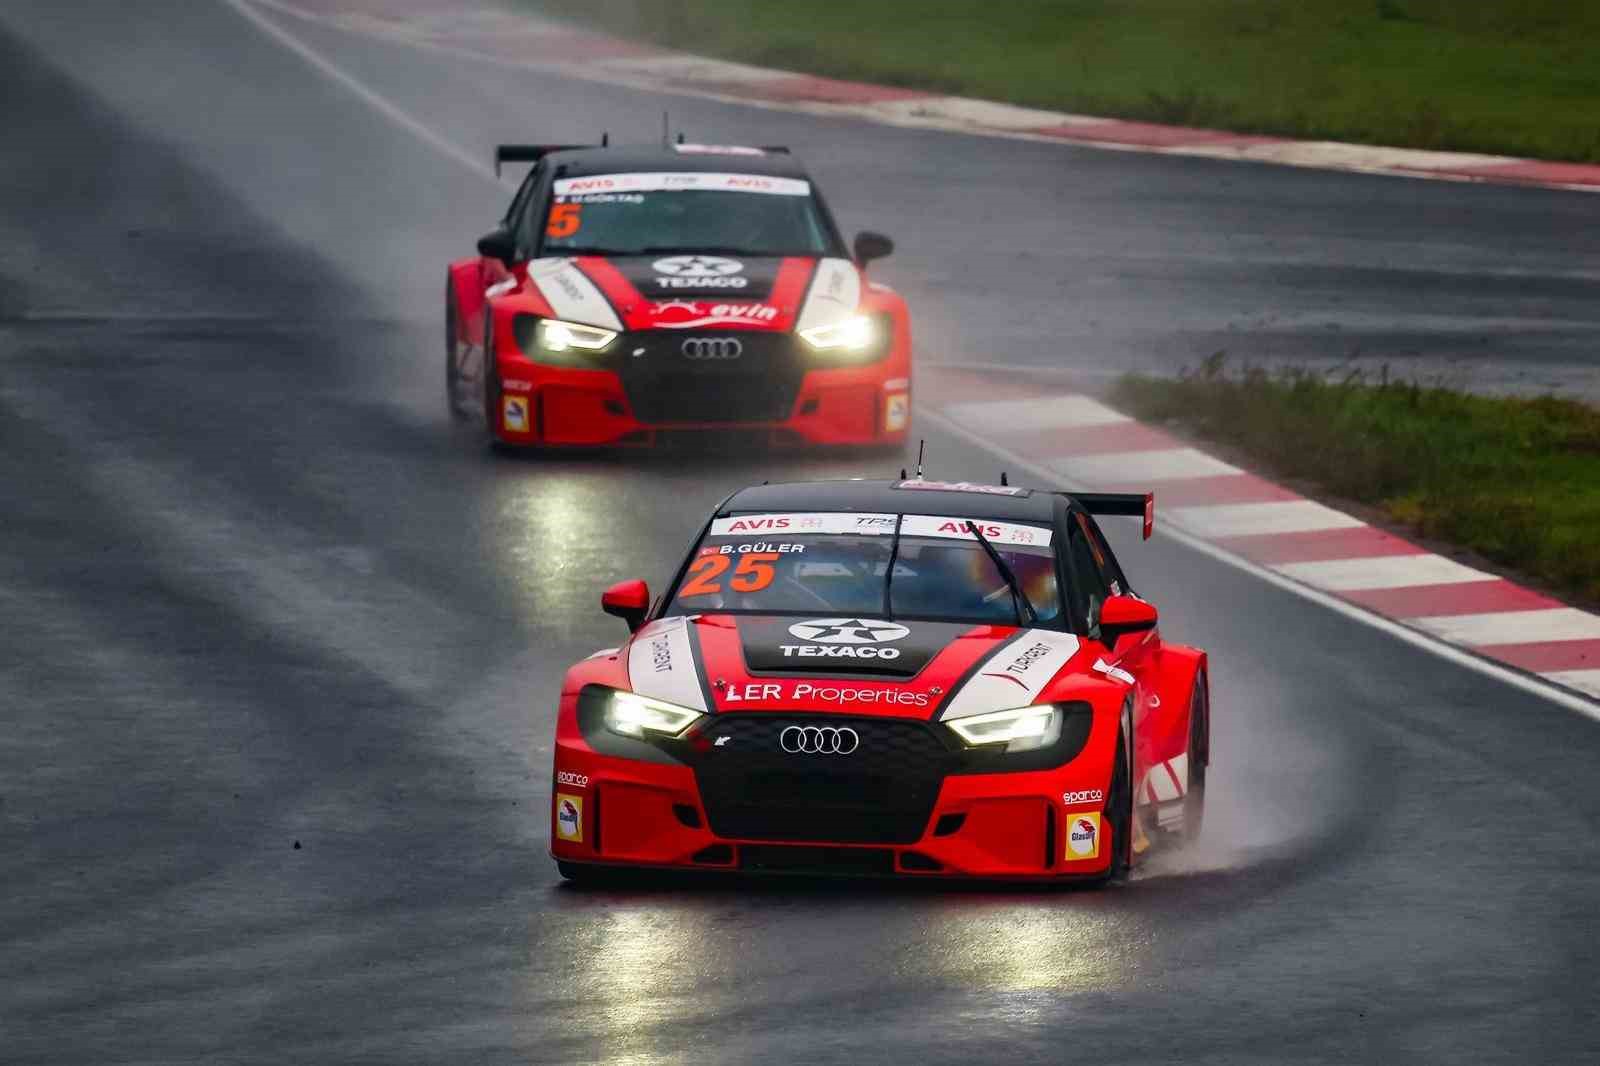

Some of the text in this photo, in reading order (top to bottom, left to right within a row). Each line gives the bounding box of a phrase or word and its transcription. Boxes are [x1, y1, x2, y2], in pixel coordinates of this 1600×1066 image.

[569, 180, 615, 192] AVIS
[546, 203, 583, 239] 5
[655, 277, 748, 289] TEXACO
[710, 303, 778, 321] evin
[728, 517, 791, 533] AVIS
[937, 521, 1002, 537] AVIS
[719, 541, 806, 554] B.GÜLER
[678, 552, 781, 598] 25
[779, 644, 901, 660] TEXACO
[791, 683, 929, 706] Properties
[1062, 789, 1103, 805] sparco
